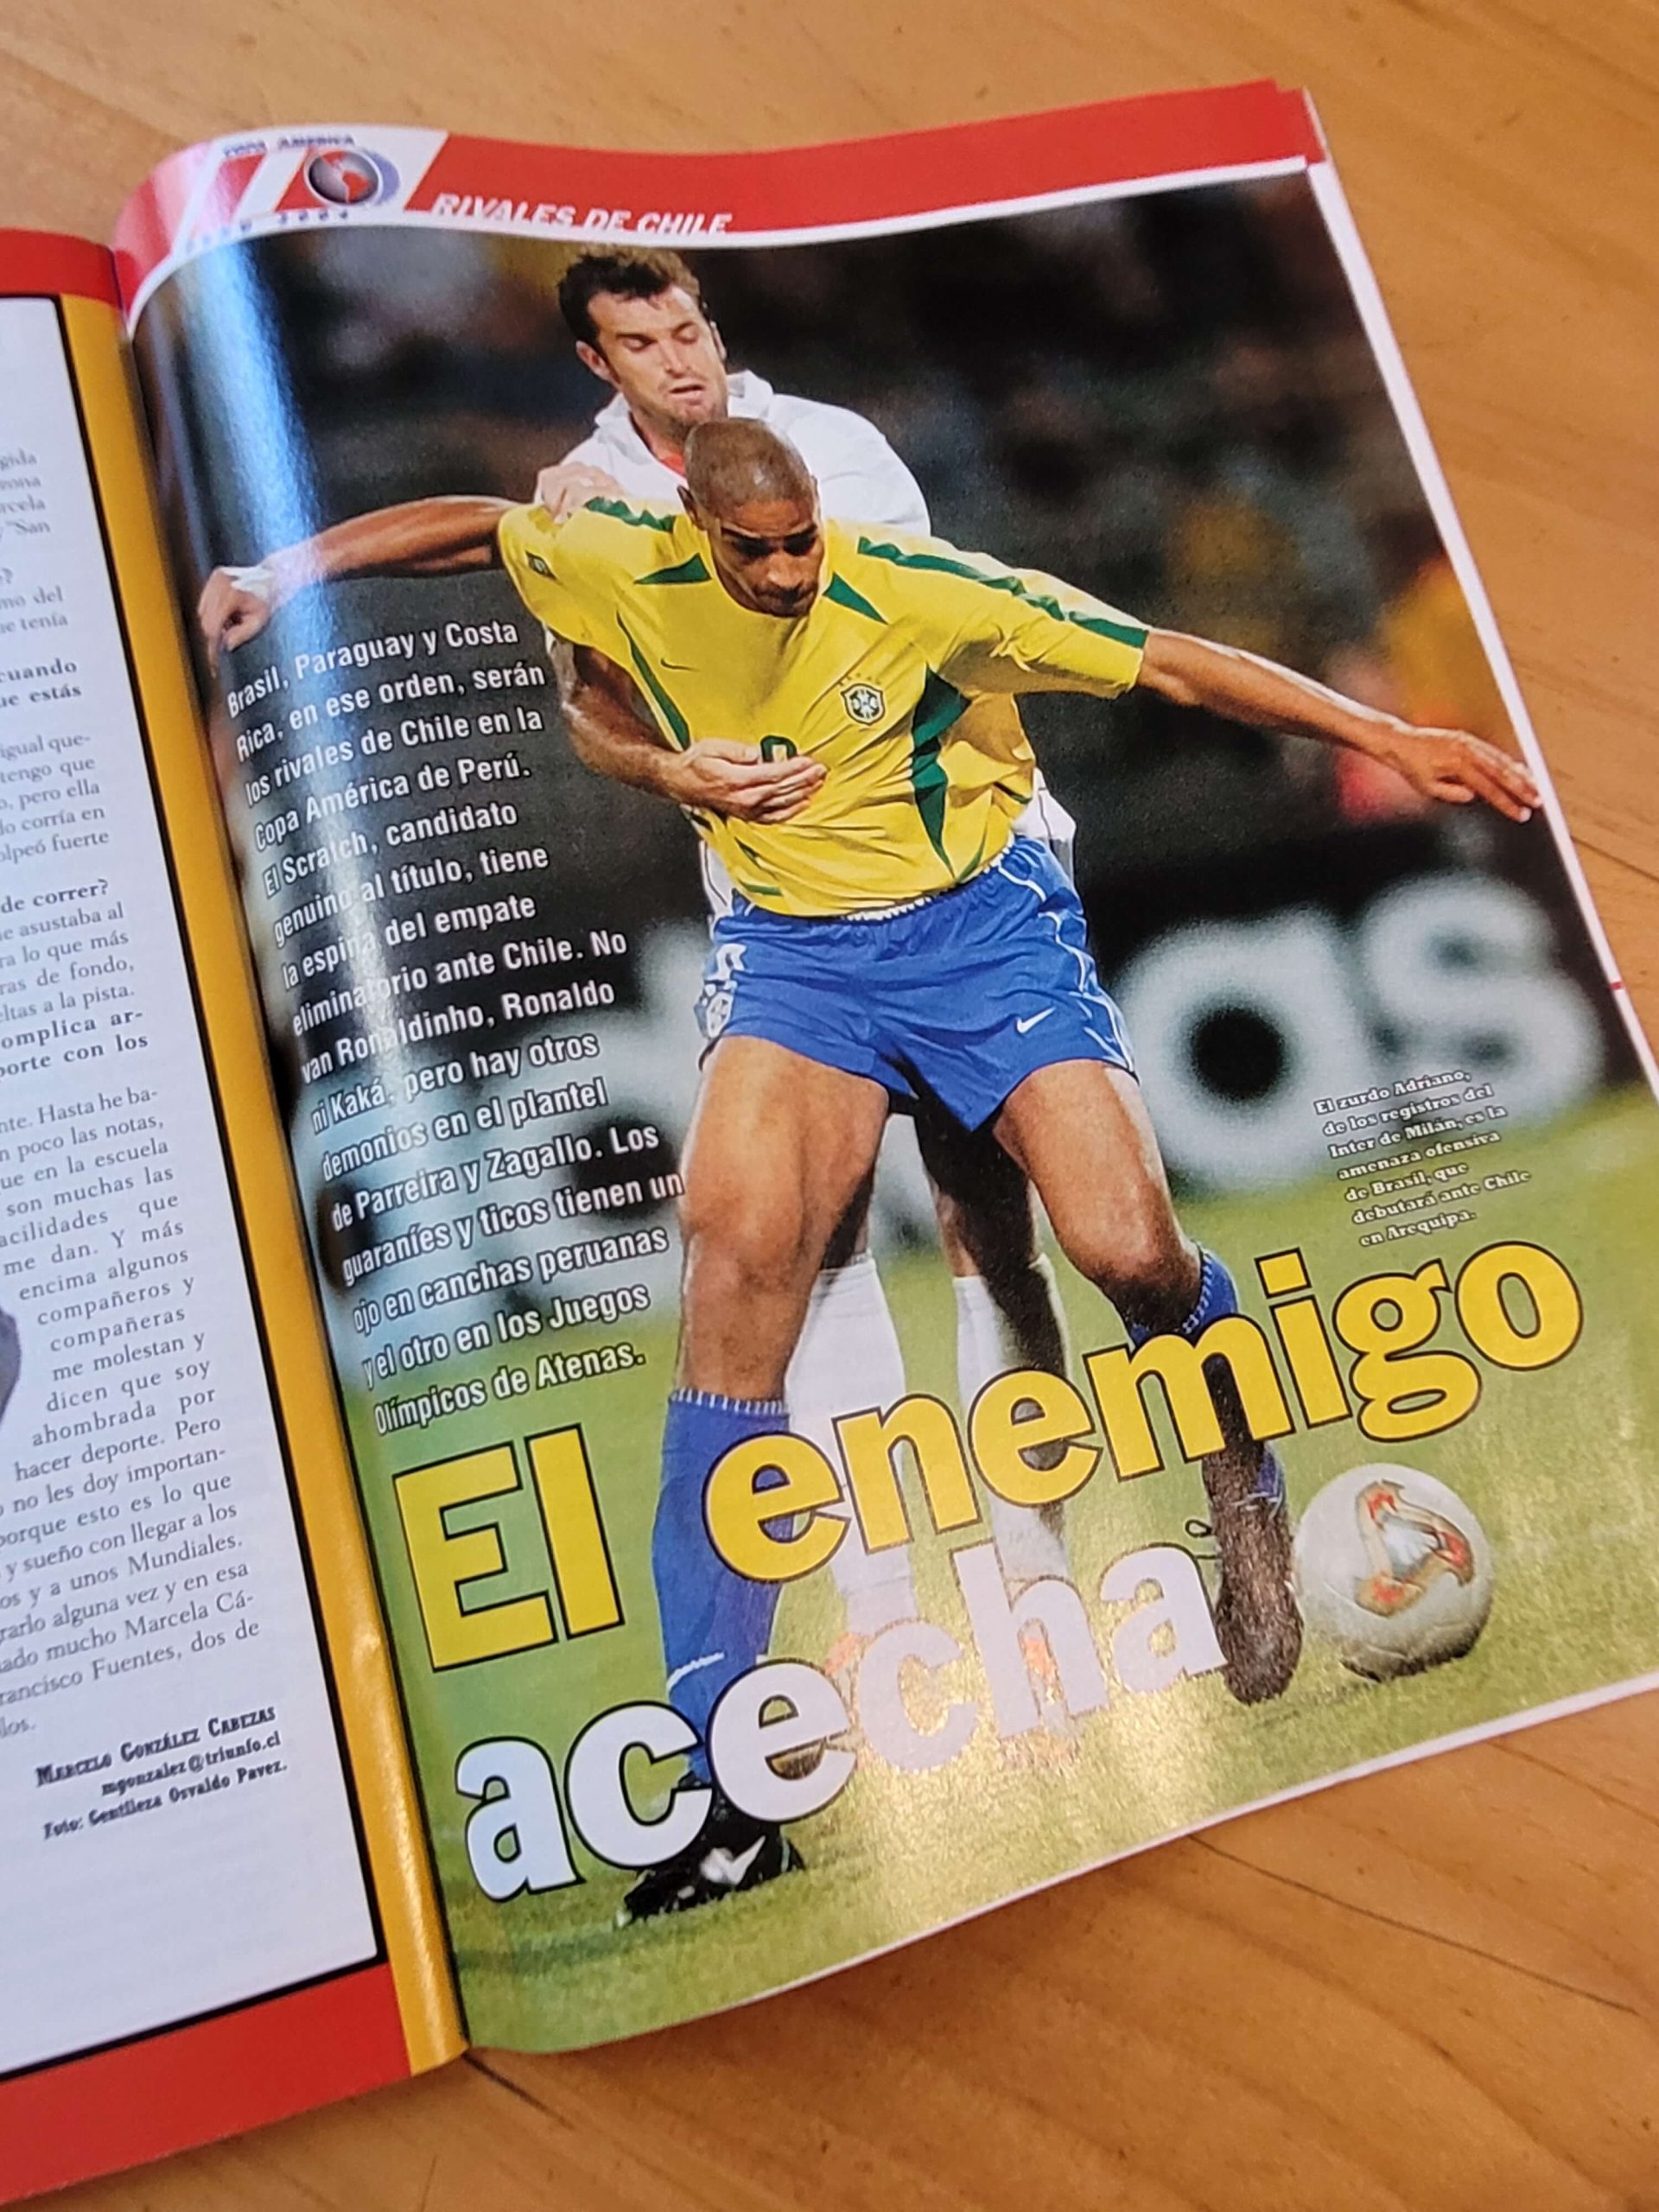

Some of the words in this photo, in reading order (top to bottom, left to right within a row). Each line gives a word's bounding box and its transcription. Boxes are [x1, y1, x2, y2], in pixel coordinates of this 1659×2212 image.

[431, 194, 575, 225] RIVALES
[582, 208, 632, 231] DE
[638, 213, 732, 235] CHILE
[226, 666, 289, 718] Brasil,
[296, 633, 414, 680] Paraguay
[421, 631, 437, 655] y
[446, 621, 518, 648] Costa
[236, 723, 283, 762] Rica,
[289, 706, 318, 730] en
[326, 689, 371, 719] ese
[378, 674, 465, 703] orden,
[473, 661, 545, 690] serán
[245, 773, 270, 808] los
[276, 740, 354, 790] rivales
[361, 729, 393, 757] de
[401, 715, 469, 747] Chile
[479, 712, 510, 735] en
[517, 709, 543, 731] la
[18, 784, 61, 811] pero
[66, 779, 100, 798] ella
[255, 811, 300, 852] Copa
[307, 773, 410, 824] América
[418, 765, 450, 791] de
[458, 753, 531, 785] Perú.
[263, 868, 279, 898] El
[283, 832, 378, 883] Scratch,
[386, 804, 518, 847] candidato
[0, 895, 29, 914] de
[32, 878, 109, 908] correr?
[273, 884, 353, 948] genuino
[361, 873, 384, 903] al
[391, 860, 474, 893] título,
[480, 846, 549, 877] tiene
[22, 946, 41, 963] lo
[47, 939, 83, 962] que
[90, 928, 130, 950] más
[283, 963, 299, 991] la
[302, 930, 377, 980] espina
[385, 913, 427, 947] del
[435, 894, 536, 935] empate
[292, 969, 428, 1037] eliminatorio
[435, 950, 495, 985] ante
[502, 937, 583, 970] Chile.
[590, 930, 627, 957] No
[63, 1040, 105, 1063] con
[116, 1033, 149, 1053] los
[302, 1052, 333, 1084] van
[337, 1006, 495, 1063] Ronaldinho,
[502, 980, 615, 1021] Ronaldo
[38, 1098, 95, 1125] Hasta
[99, 1092, 123, 1112] he
[127, 1086, 158, 1106] ba-
[312, 1107, 327, 1135] ni
[405, 1061, 463, 1103] pero
[470, 1046, 519, 1079] hay
[529, 1034, 600, 1066] otros
[1315, 1100, 1335, 1115] El
[1338, 1089, 1390, 1109] zurdo
[1393, 1070, 1471, 1096] Adriano,
[1323, 1122, 1346, 1136] de
[1351, 1115, 1377, 1131] los
[1382, 1094, 1460, 1122] registros
[1464, 1084, 1494, 1103] del
[34, 1167, 58, 1183] en
[67, 1156, 85, 1175] la
[94, 1136, 169, 1167] escuela
[322, 1123, 426, 1182] demonios
[433, 1112, 468, 1141] en
[476, 1100, 503, 1128] el
[512, 1078, 607, 1128] plantel
[1329, 1140, 1376, 1159] Inter
[1380, 1130, 1402, 1147] de
[1405, 1116, 1464, 1140] Milán,
[1465, 1111, 1484, 1125] es
[1488, 1105, 1508, 1119] la
[1338, 1153, 1421, 1181] amenaza
[1426, 1131, 1501, 1157] ofensiva
[6, 1199, 43, 1217] son
[54, 1174, 135, 1206] muchas
[145, 1166, 175, 1185] las
[331, 1199, 351, 1232] de
[356, 1167, 455, 1219] Parreira
[463, 1162, 480, 1192] y
[486, 1137, 603, 1180] Zagallo.
[610, 1124, 659, 1154] Los
[1344, 1187, 1369, 1203] de
[1371, 1173, 1433, 1196] Brasil,
[1434, 1162, 1468, 1182] que
[1352, 1192, 1436, 1224] debutará
[1440, 1182, 1480, 1203] ante
[1484, 1170, 1531, 1191] Chile
[3, 1258, 35, 1276] me
[111, 1229, 125, 1249] Y
[142, 1219, 184, 1243] más
[342, 1224, 450, 1287] guaraníes
[454, 1218, 473, 1249] y
[480, 1198, 550, 1236] ticos
[554, 1179, 643, 1219] tienen
[651, 1173, 686, 1199] un
[1359, 1233, 1383, 1247] en
[1387, 1211, 1477, 1241] Arequipa.
[19, 1269, 97, 1301] encima
[107, 1249, 189, 1281] algunos
[37, 1281, 171, 1326] compañeros
[182, 1276, 195, 1296] y
[353, 1301, 378, 1334] ojo
[385, 1290, 413, 1319] en
[421, 1256, 531, 1307] canchas
[541, 1228, 668, 1282] peruanas
[53, 1363, 83, 1382] me
[92, 1338, 186, 1372] molestan
[193, 1332, 206, 1352] y
[363, 1358, 375, 1389] y
[376, 1348, 395, 1378] el
[401, 1332, 448, 1370] otro
[456, 1325, 490, 1353] en
[499, 1307, 542, 1342] los
[550, 1285, 649, 1329] Juegos
[374, 1380, 486, 1435] Olímpicos
[493, 1366, 528, 1400] de
[537, 1342, 645, 1389] Atenas.
[14, 1453, 73, 1482] hacer
[81, 1433, 166, 1465] deporte.
[175, 1417, 221, 1440] Pero
[393, 1423, 624, 1674] El
[705, 1241, 1583, 1582] enemigo
[78, 1504, 120, 1527] esto
[130, 1496, 152, 1512] es
[162, 1484, 182, 1504] lo
[193, 1474, 232, 1501] que
[46, 1628, 117, 1662] mucho
[124, 1601, 208, 1640] Marcela
[216, 1590, 254, 1613] Cá-
[92, 1647, 183, 1681] Fuentes,
[190, 1630, 226, 1653] dos
[235, 1618, 260, 1640] de
[454, 1541, 1229, 1904] acecha
[169, 1773, 230, 1804] Osvaldo
[237, 1758, 287, 1785] Pavez.
